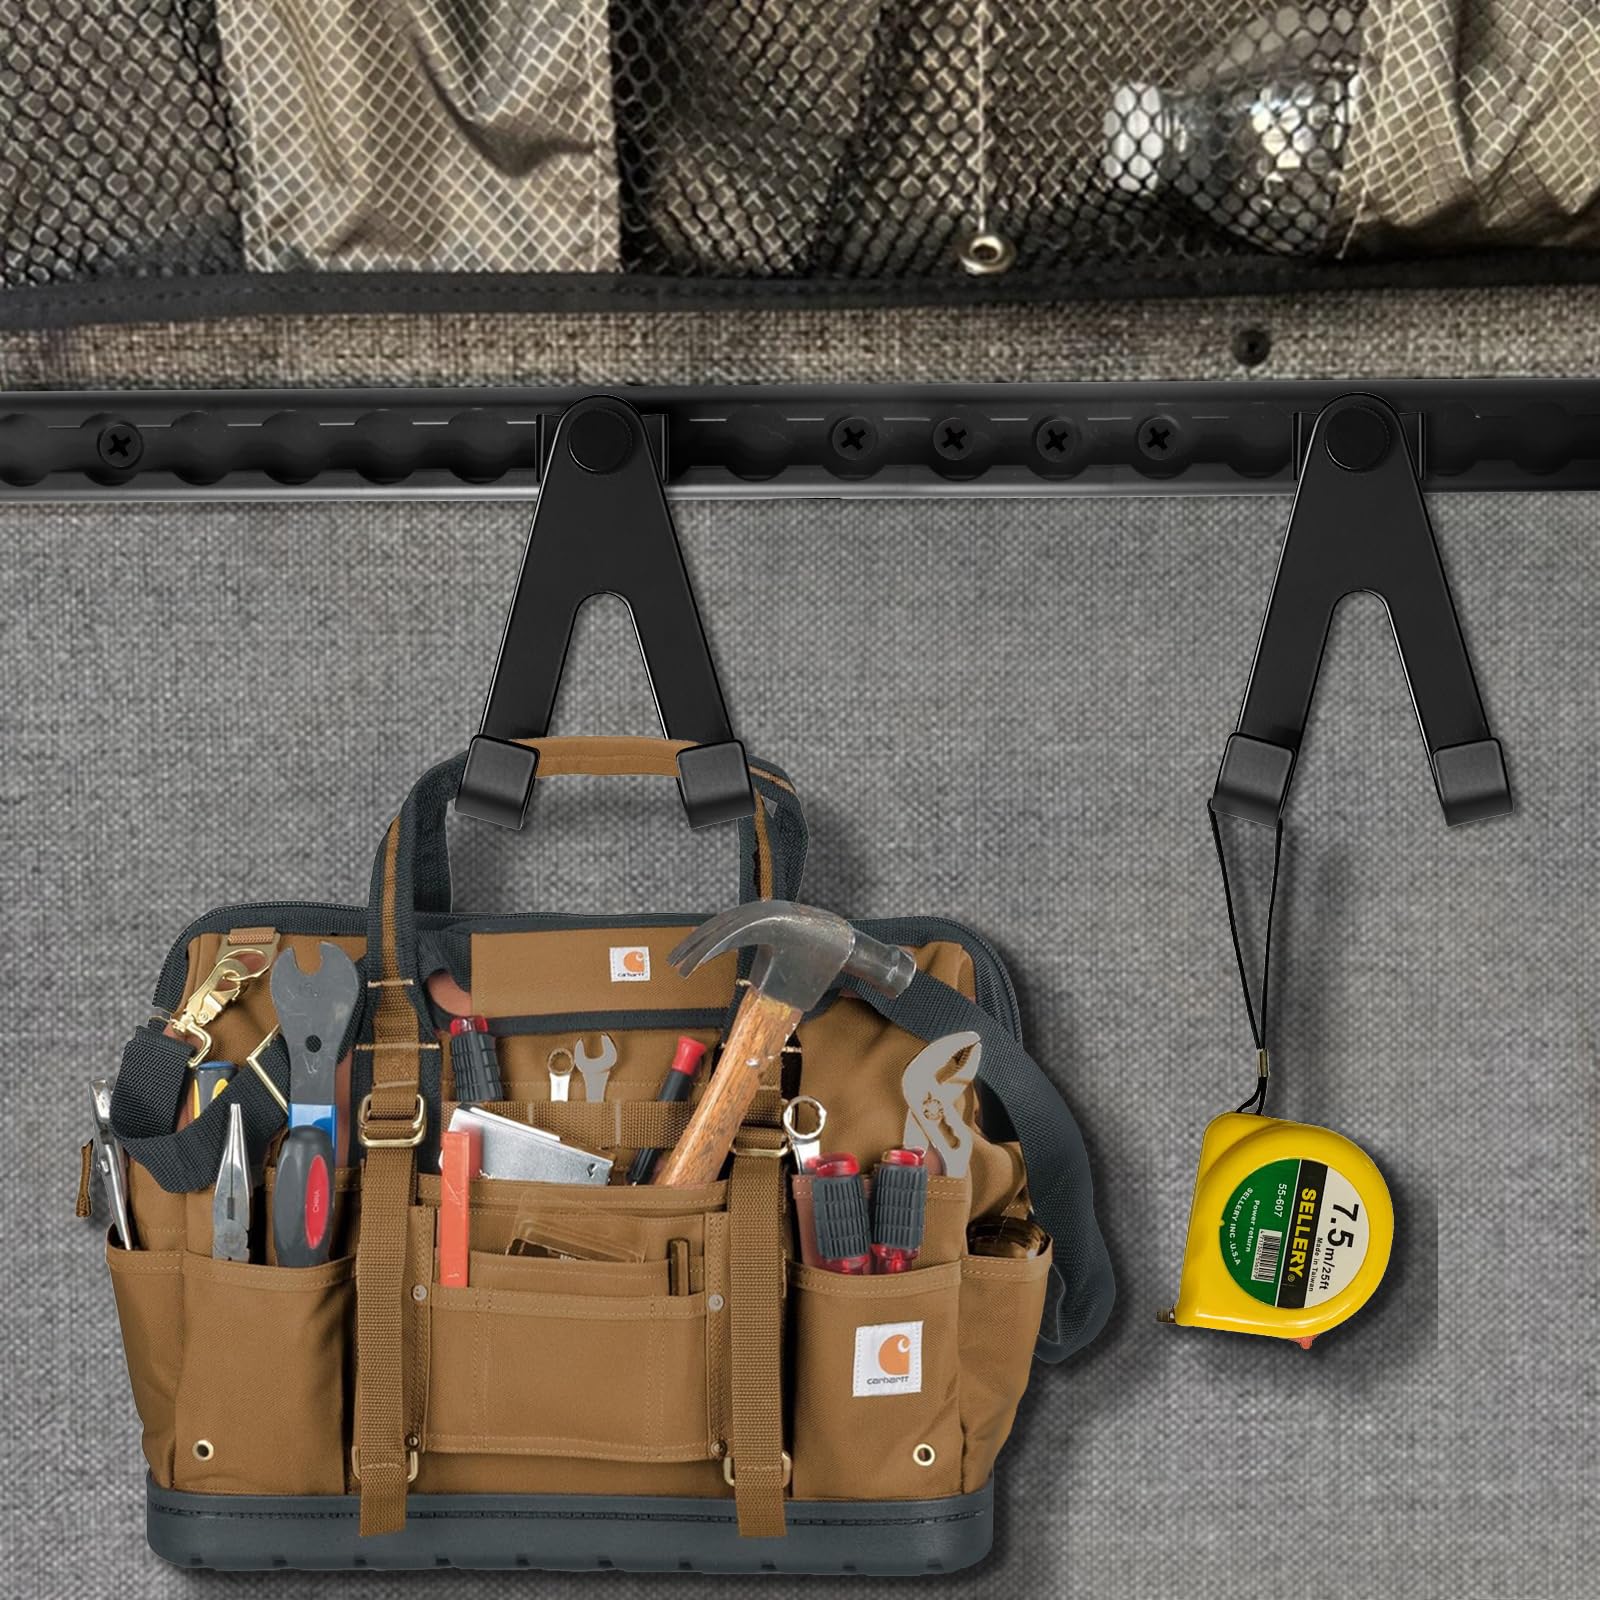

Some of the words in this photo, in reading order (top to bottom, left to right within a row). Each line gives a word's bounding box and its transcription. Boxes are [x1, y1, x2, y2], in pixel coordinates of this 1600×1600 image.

[1231, 1187, 1254, 1222] SELLERY
[1250, 1200, 1261, 1225] Power
[1273, 1183, 1288, 1218] 55-607
[1245, 1226, 1255, 1252] return
[1314, 1237, 1323, 1257] Made
[1308, 1268, 1319, 1292] Taiwan
